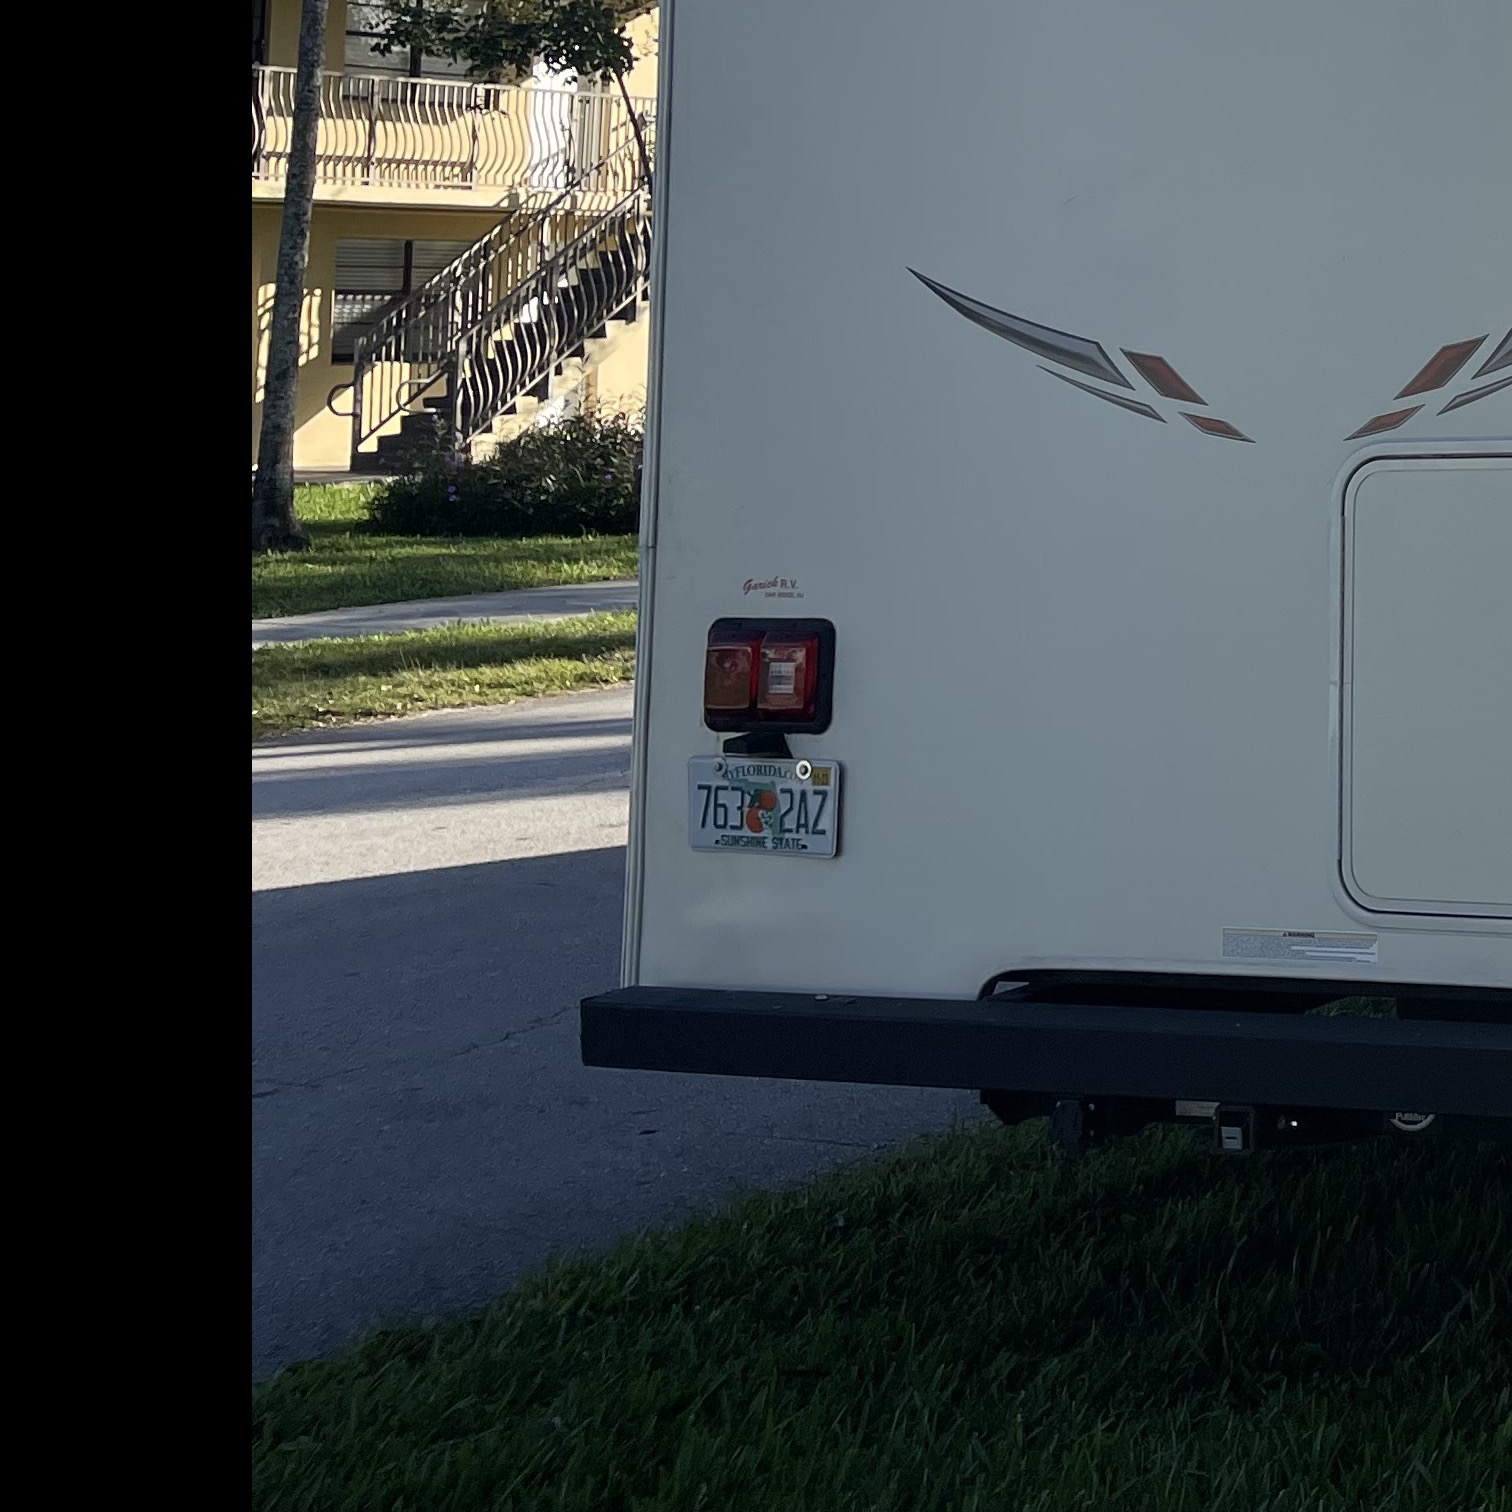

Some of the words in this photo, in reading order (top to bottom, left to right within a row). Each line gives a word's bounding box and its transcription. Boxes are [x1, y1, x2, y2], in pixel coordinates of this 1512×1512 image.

[697, 784, 745, 830] 763
[779, 788, 828, 835] 2AZ
[720, 834, 768, 849] SUNSHINE
[772, 837, 802, 850] STATE
